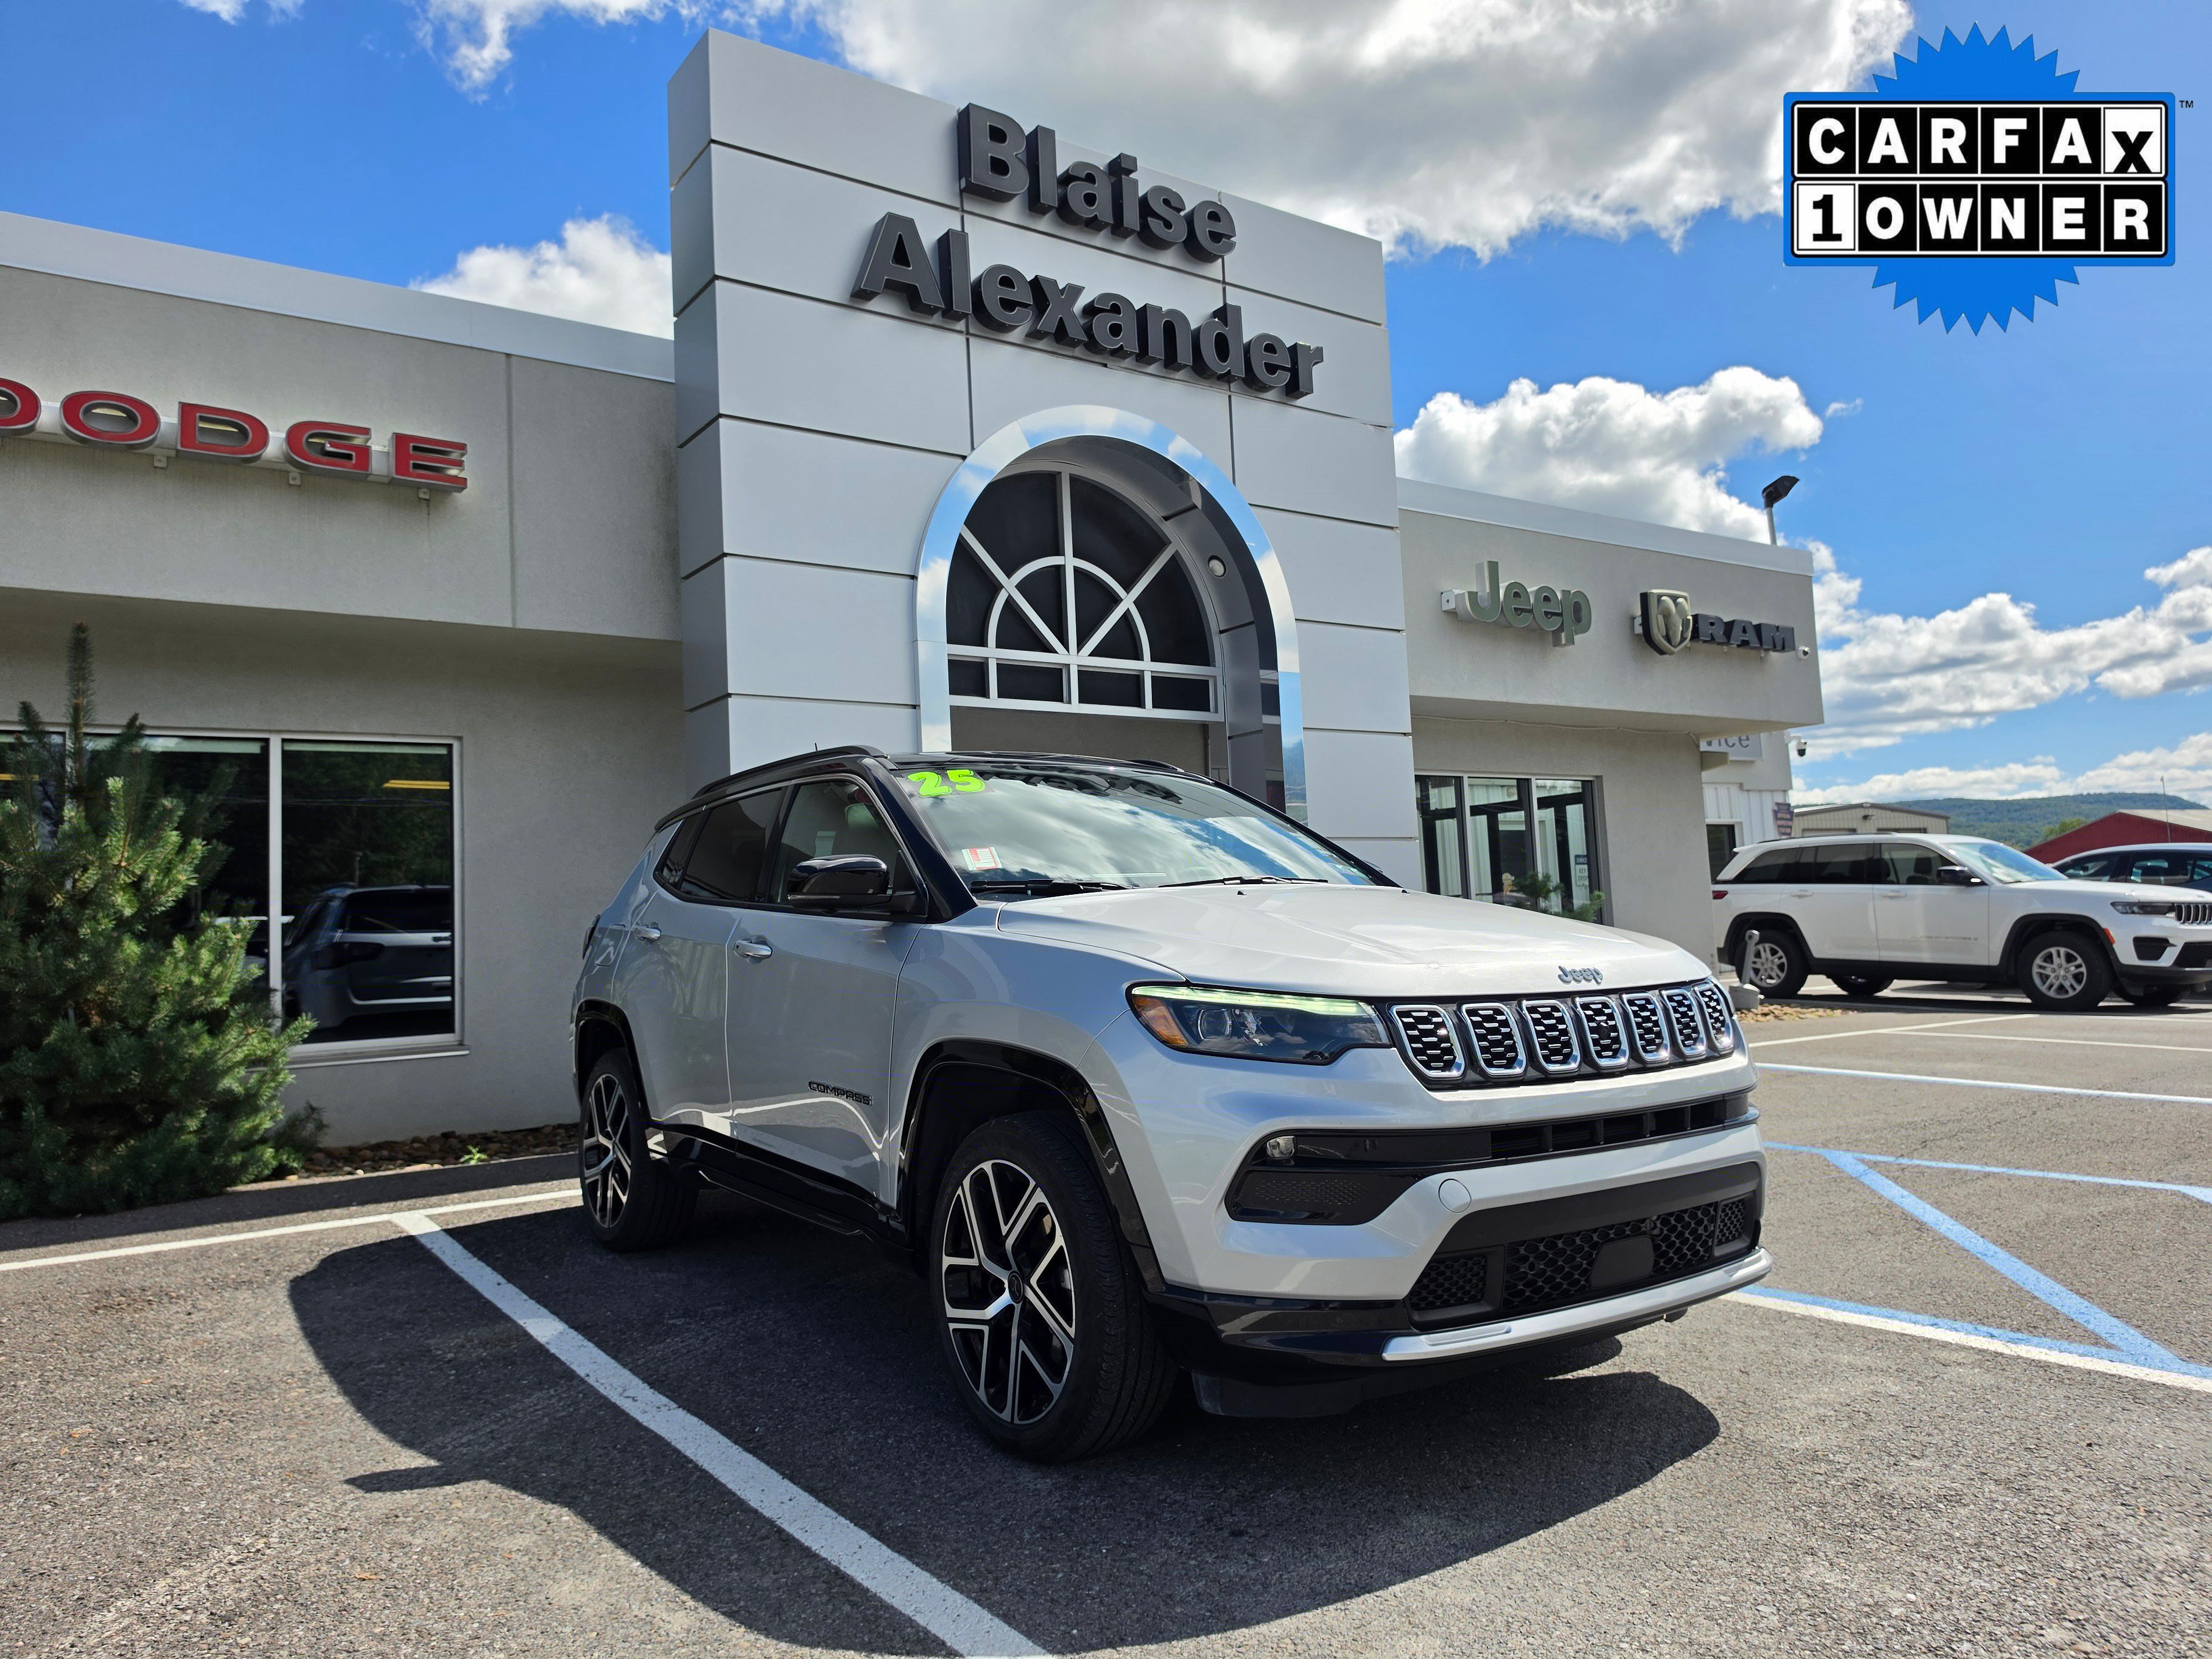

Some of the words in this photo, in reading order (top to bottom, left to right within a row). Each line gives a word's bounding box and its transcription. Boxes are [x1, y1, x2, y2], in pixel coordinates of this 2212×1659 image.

[958, 102, 1237, 263] Blaise
[851, 211, 1323, 400] Alexander
[1459, 560, 1592, 647] Jeep
[1691, 613, 1796, 653] RAM
[907, 769, 985, 797] 25
[1558, 966, 1604, 985] Jeep
[808, 1080, 874, 1106] COMPASS
